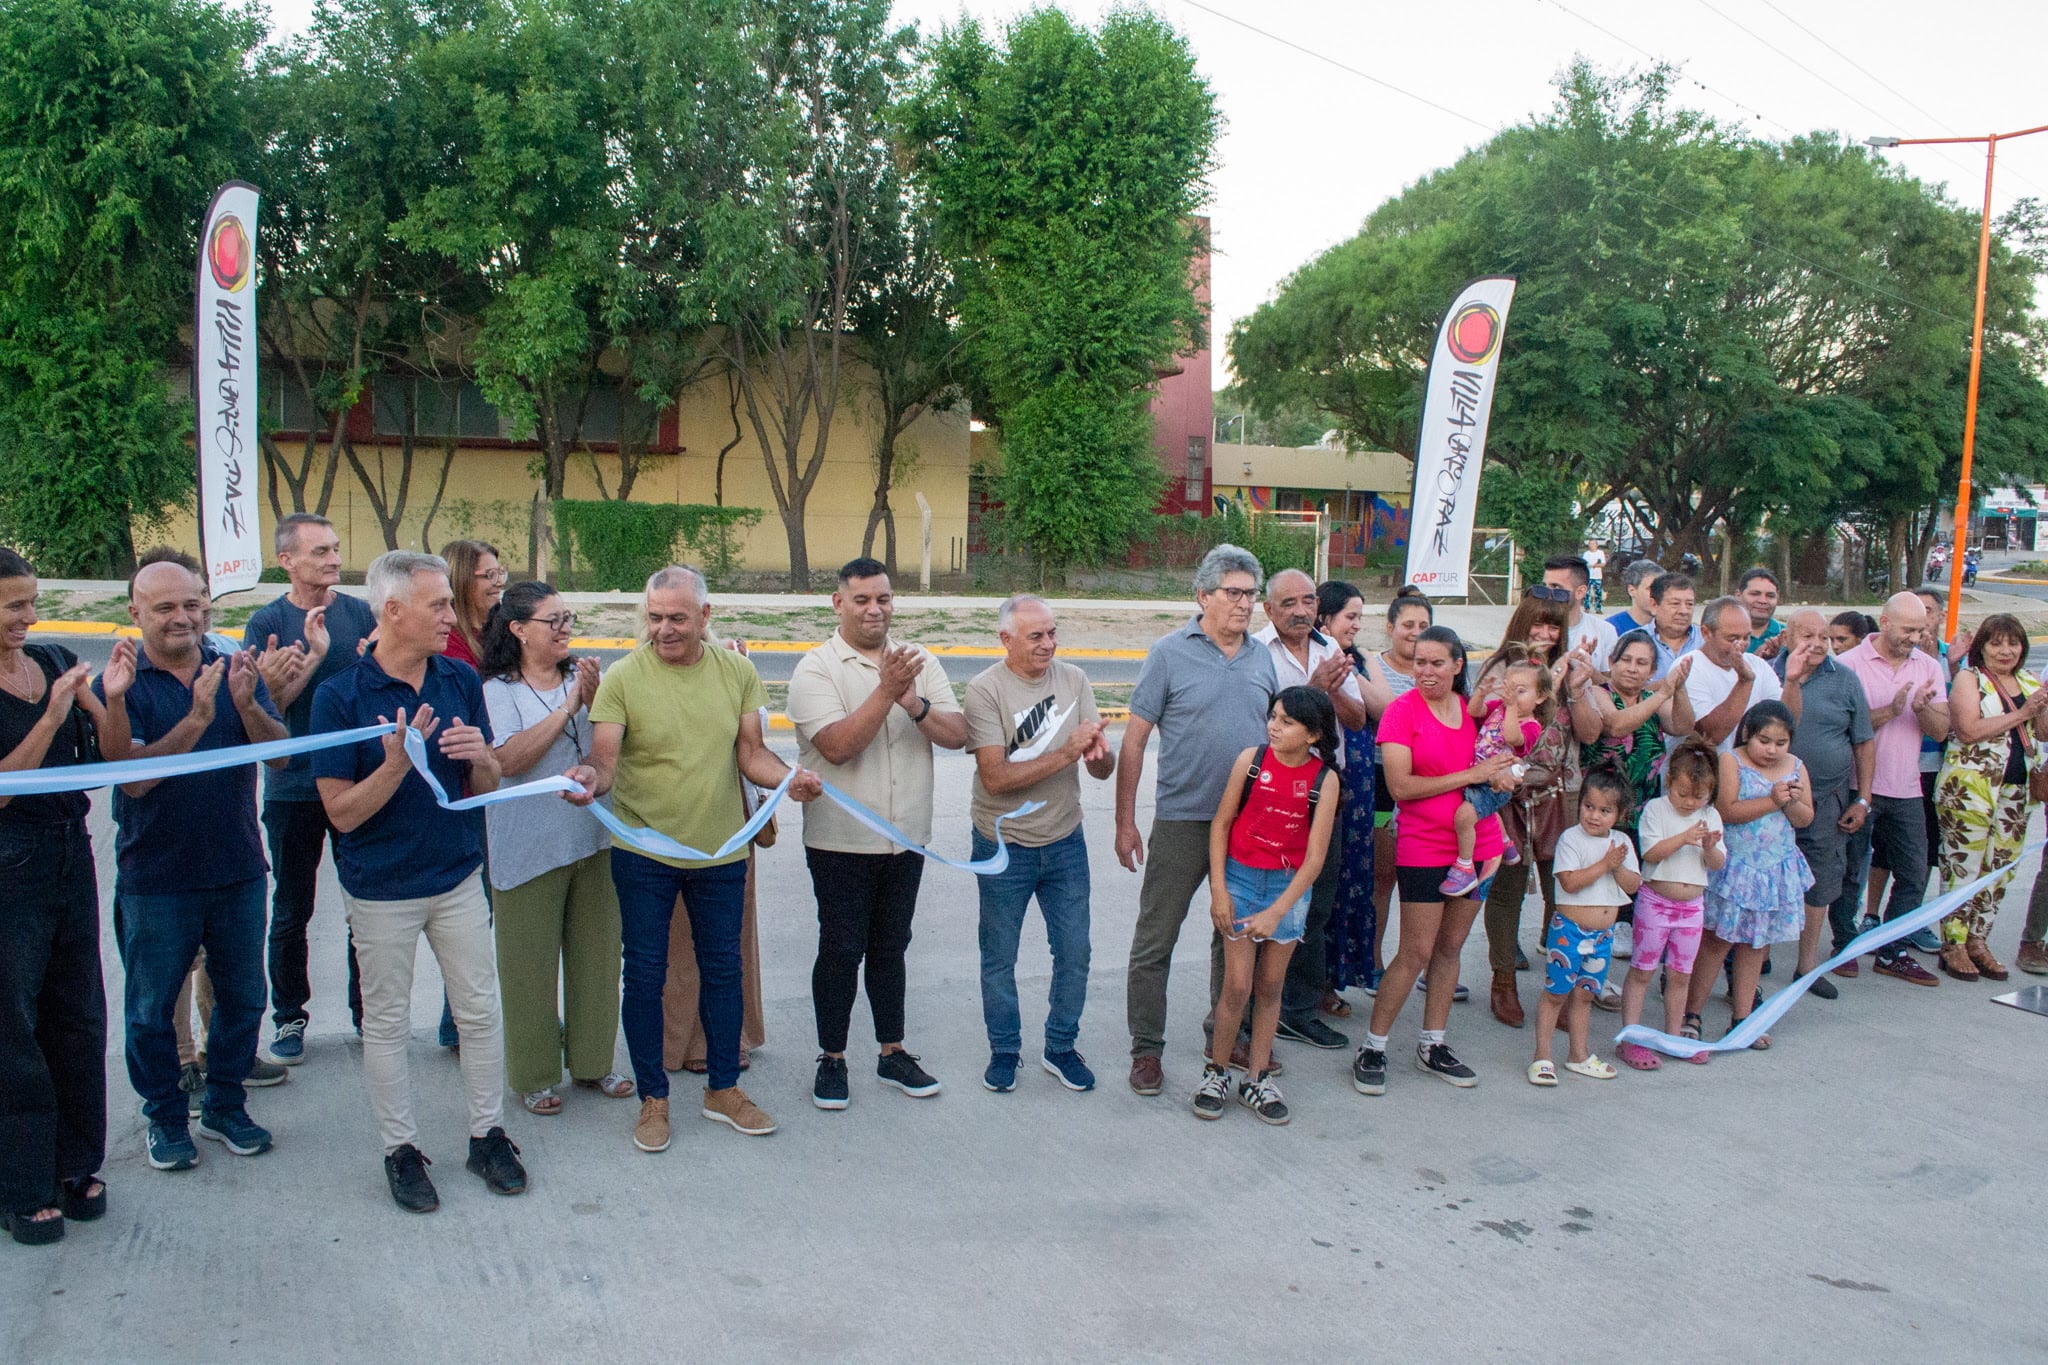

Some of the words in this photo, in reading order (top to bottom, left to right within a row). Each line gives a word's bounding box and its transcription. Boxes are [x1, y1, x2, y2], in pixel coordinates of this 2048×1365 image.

[215, 298, 243, 379] VILLA
[1446, 370, 1483, 432] VILLA
[1437, 432, 1472, 495] CARLOS
[222, 458, 248, 540] PAZ
[1432, 495, 1456, 557] PAZ
[214, 558, 258, 576] CAPTUR
[1411, 572, 1459, 584] CAPTUR
[1014, 694, 1063, 743] NIKE
